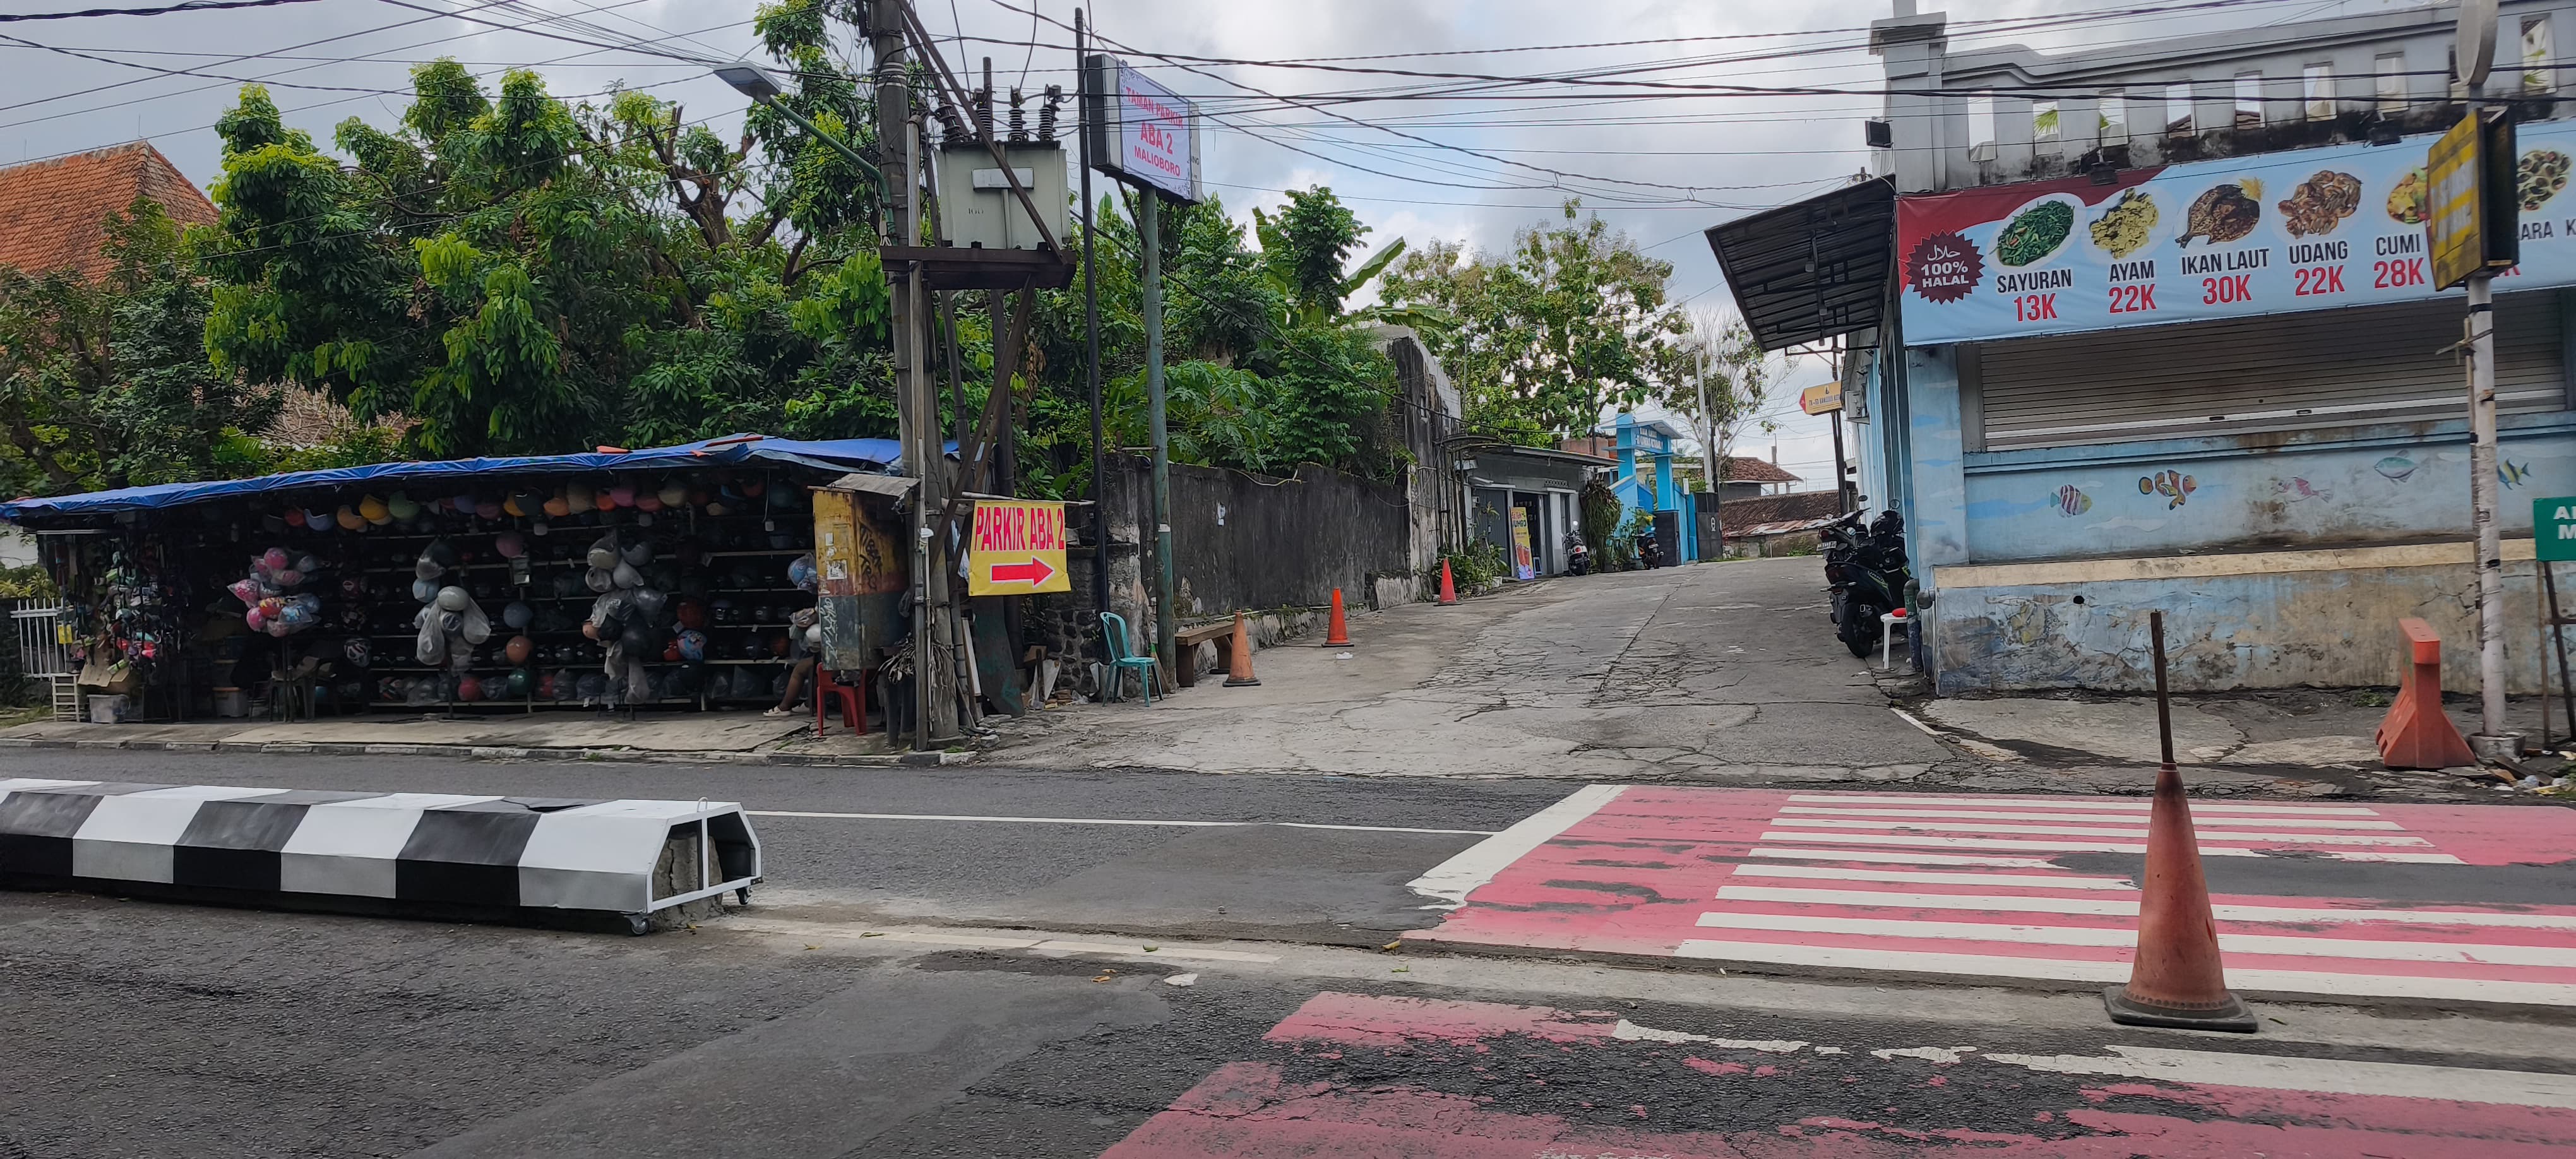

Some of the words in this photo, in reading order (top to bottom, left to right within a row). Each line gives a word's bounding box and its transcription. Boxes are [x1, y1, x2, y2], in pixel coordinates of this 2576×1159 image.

[1126, 86, 1154, 114] TAMAN
[1156, 102, 1183, 129] PARKIR
[1140, 121, 1164, 153] ABA
[1167, 133, 1173, 155] 2
[1134, 145, 1180, 177] MALIOBORO
[2376, 234, 2421, 256] CUMI
[2520, 221, 2554, 241] ARA
[1927, 244, 1960, 261] حلال
[2181, 253, 2222, 275] IKAN
[2227, 248, 2269, 270] LAUT
[2289, 241, 2348, 264] UDANG
[1921, 260, 1969, 276] 100%
[1922, 275, 1969, 288] HALAL
[1996, 269, 2072, 294] SAYURAN
[2109, 260, 2155, 283] AYAM
[2294, 264, 2346, 296] 22K
[2373, 257, 2424, 289] 28K
[2109, 283, 2157, 313] 22K
[2202, 273, 2253, 305] 30K
[2013, 293, 2058, 322] 13K
[974, 506, 1025, 550] PARKIR
[1030, 508, 1055, 550] ABA
[1057, 508, 1064, 549] 2
